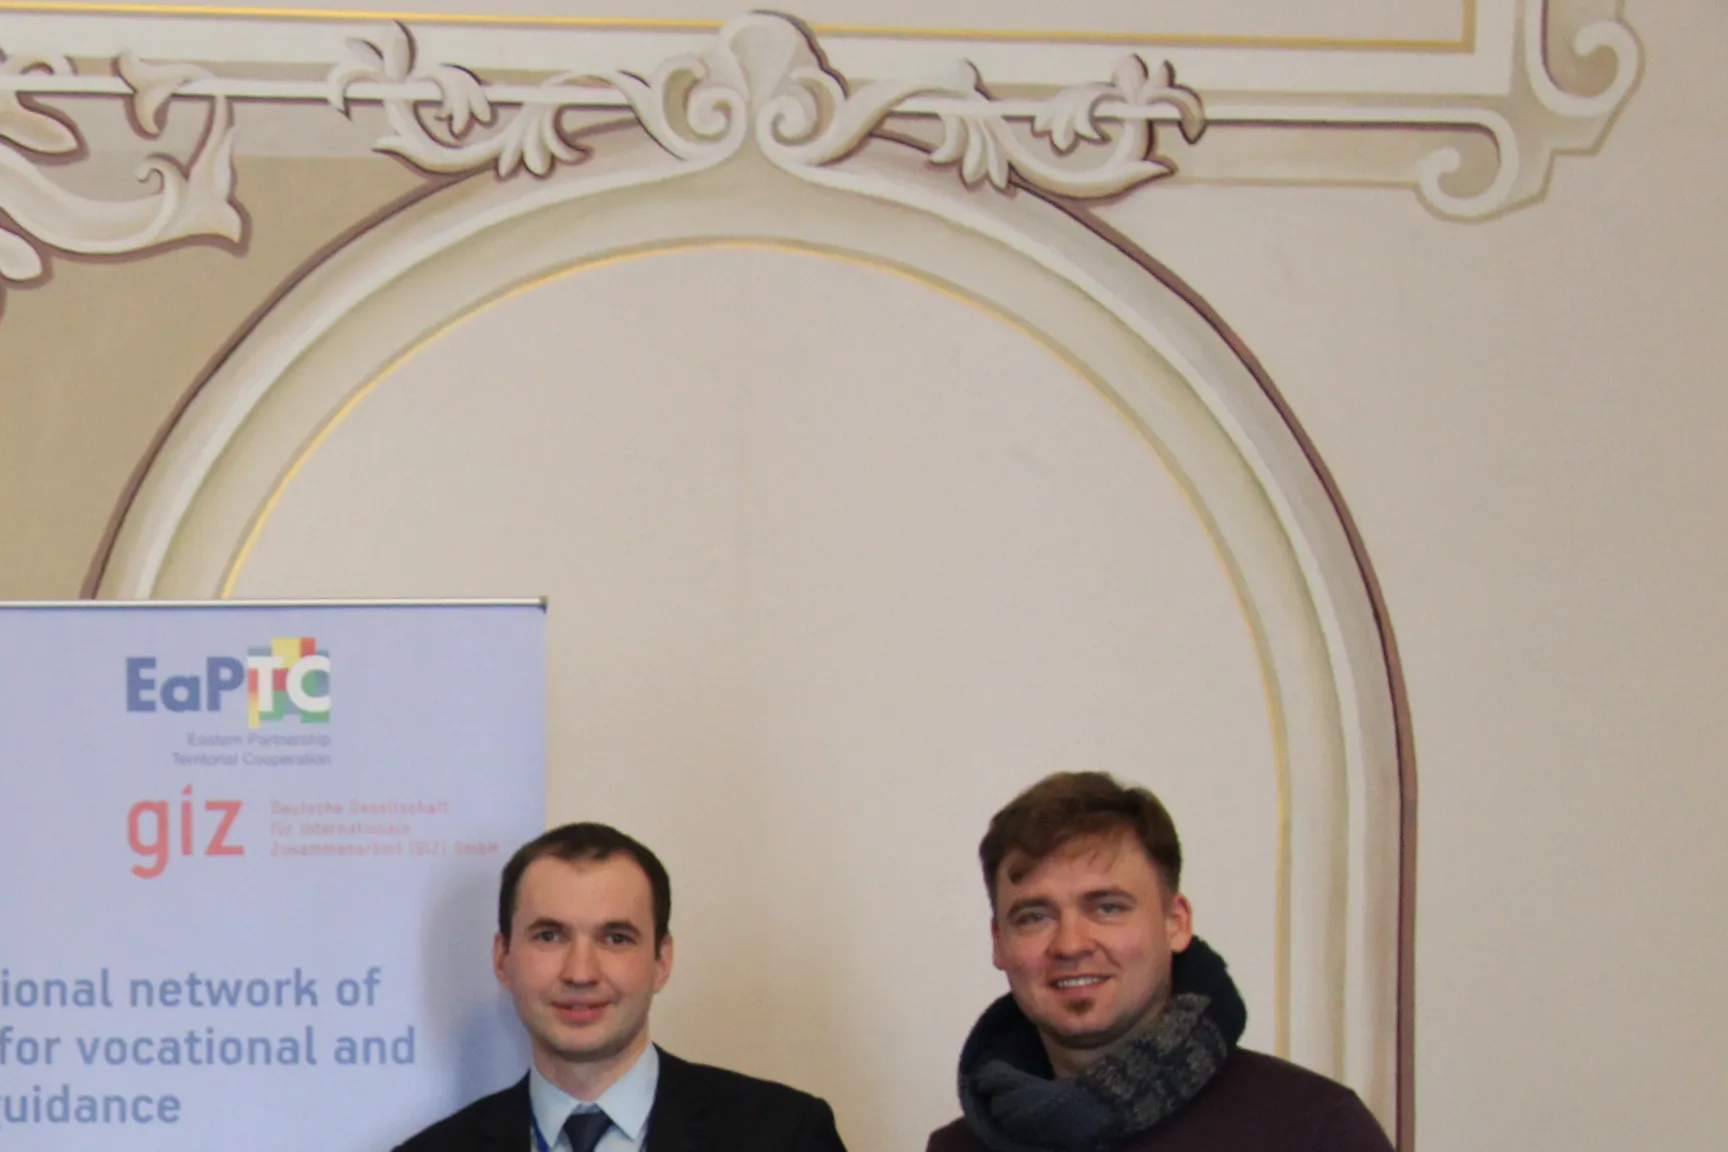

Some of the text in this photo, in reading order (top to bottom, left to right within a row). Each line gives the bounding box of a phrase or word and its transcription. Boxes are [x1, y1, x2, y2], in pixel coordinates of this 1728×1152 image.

[125, 655, 332, 713] EaPTC
[127, 784, 245, 880] giz
[129, 967, 318, 1008] network
[334, 967, 383, 1008] of
[76, 1025, 317, 1067] vocational
[333, 1025, 416, 1066] and
